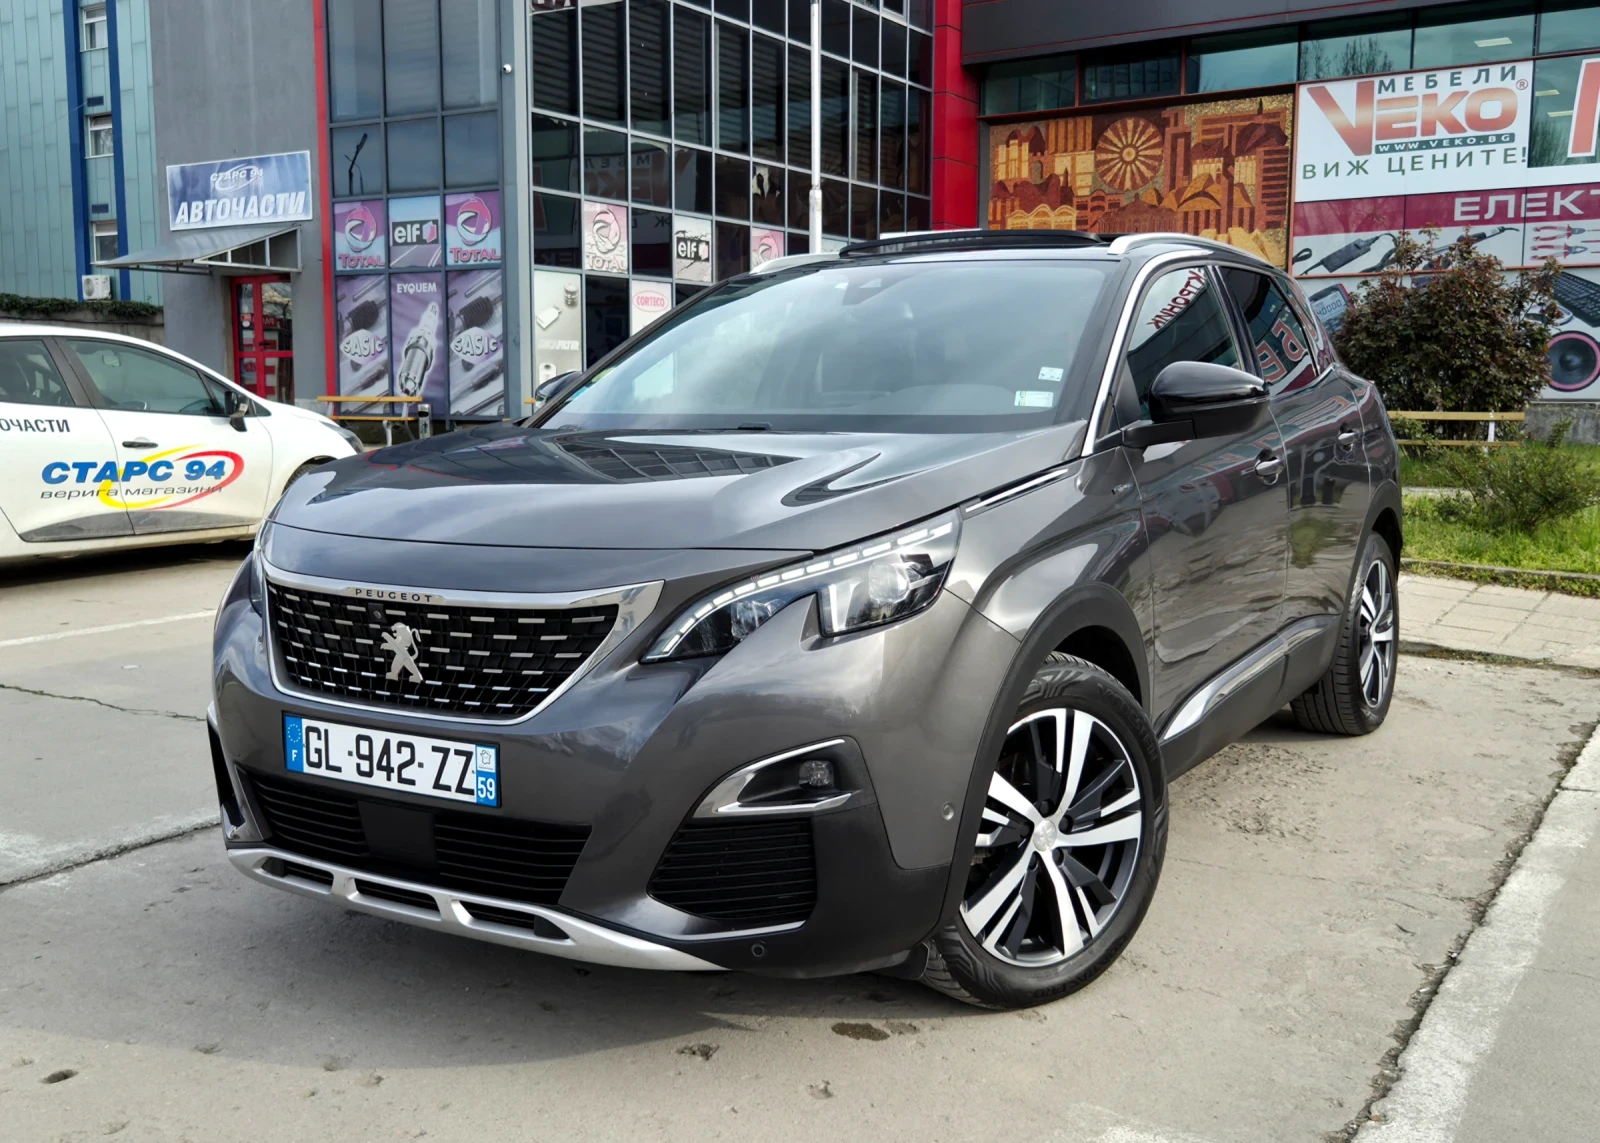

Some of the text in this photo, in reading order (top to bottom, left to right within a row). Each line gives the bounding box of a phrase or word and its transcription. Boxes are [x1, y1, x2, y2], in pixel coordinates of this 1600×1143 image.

[1377, 65, 1517, 95] МЕБЕЛИ
[1306, 80, 1518, 157] VEKO
[1302, 146, 1528, 180] ВИЖ ЦЕНИТЕ!
[210, 168, 264, 183] СТАРС 94
[175, 191, 306, 225] АВТОЧАСТИ
[394, 224, 421, 244] elf
[677, 240, 698, 259] elf
[396, 282, 437, 295] EYQUEM
[636, 296, 665, 307] CORTECO
[342, 335, 384, 358] SASIC
[453, 334, 499, 358] SASIC
[42, 460, 226, 484] СТАРС 94
[40, 484, 223, 500] верига магазини
[355, 588, 432, 603] PEUGEOT
[292, 750, 297, 761] F
[477, 776, 495, 800] 59
